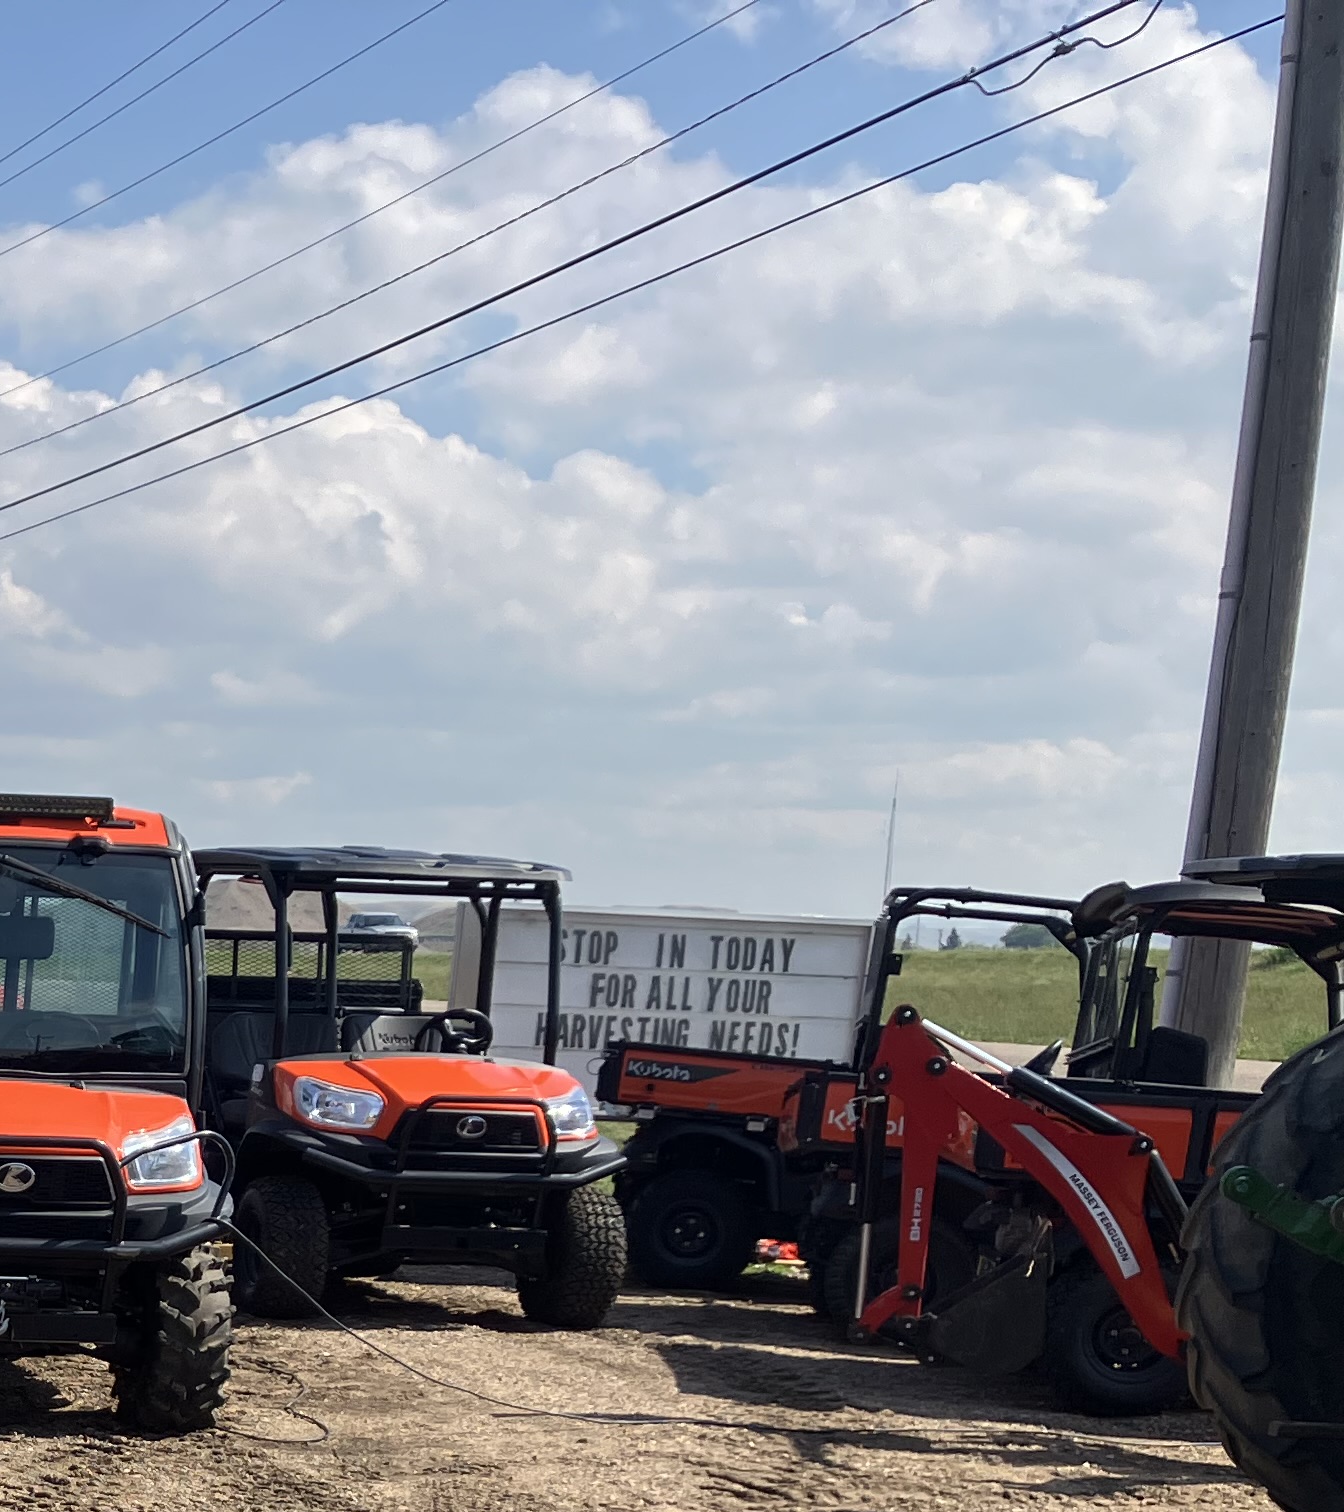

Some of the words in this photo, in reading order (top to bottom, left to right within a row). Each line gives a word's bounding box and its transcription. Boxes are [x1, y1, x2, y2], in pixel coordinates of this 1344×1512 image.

[558, 929, 619, 965] STOP
[655, 933, 687, 968] IN
[710, 935, 797, 973] TODAY
[589, 973, 637, 1009] FOR
[646, 975, 693, 1012] ALL
[707, 977, 773, 1015] YOUR
[708, 1019, 801, 1057] NEEDS!
[629, 1060, 691, 1081] Kubota
[1069, 1173, 1101, 1210] MASSEY
[1096, 1211, 1131, 1262] FERGUSON
